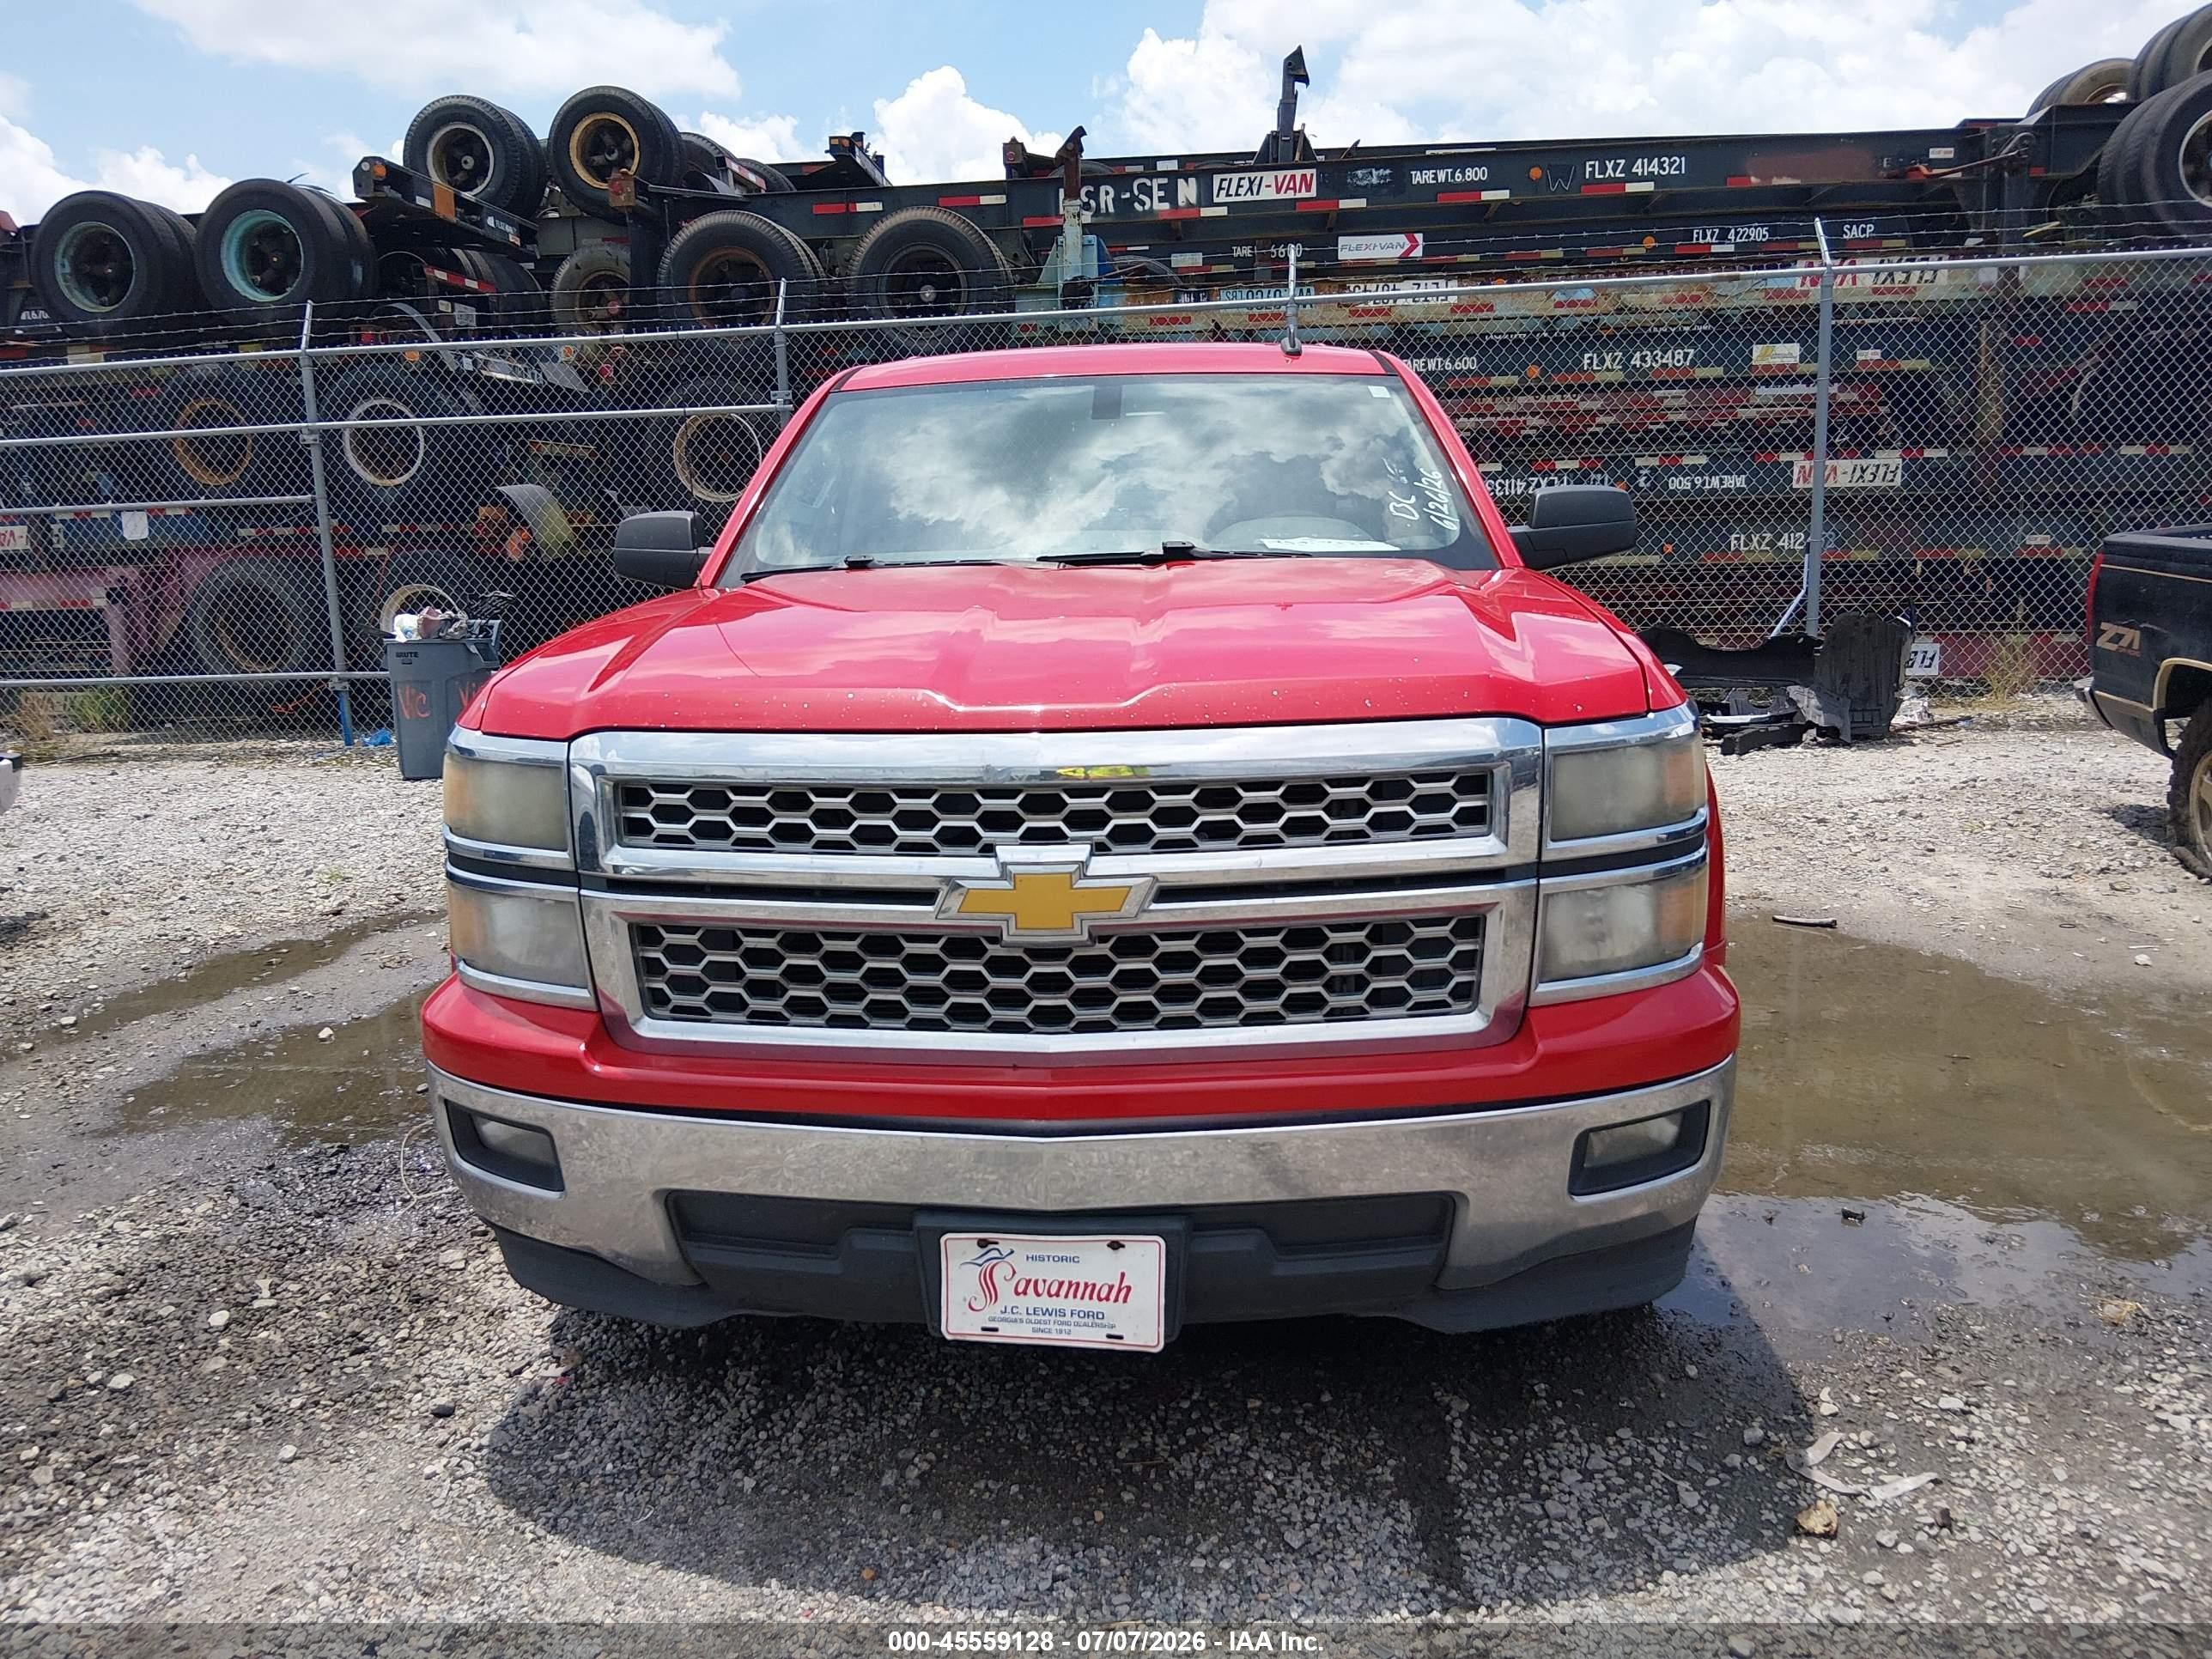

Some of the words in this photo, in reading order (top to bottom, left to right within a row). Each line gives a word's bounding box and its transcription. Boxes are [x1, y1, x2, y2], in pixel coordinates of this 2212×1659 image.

[1585, 159, 1625, 179] FLXZ
[1632, 156, 1686, 177] 414321
[1216, 172, 1315, 198] FLEXI-VAN
[1692, 228, 1719, 244] FLXZ
[1727, 226, 1769, 243] 422905
[1843, 223, 1875, 240] SACP
[1583, 352, 1623, 371] FLXZ
[1631, 349, 1695, 368] 433487
[1025, 1254, 1080, 1264] HISTORIC
[968, 1260, 1133, 1312] Savannah
[1000, 1305, 1022, 1316] J.C.
[1025, 1307, 1066, 1318] LEWIS
[1070, 1310, 1105, 1321] FORD
[988, 1316, 1024, 1324] GEORGIA'S
[1025, 1317, 1052, 1326] OLDEST
[1073, 1321, 1116, 1329] DEALERSHIP
